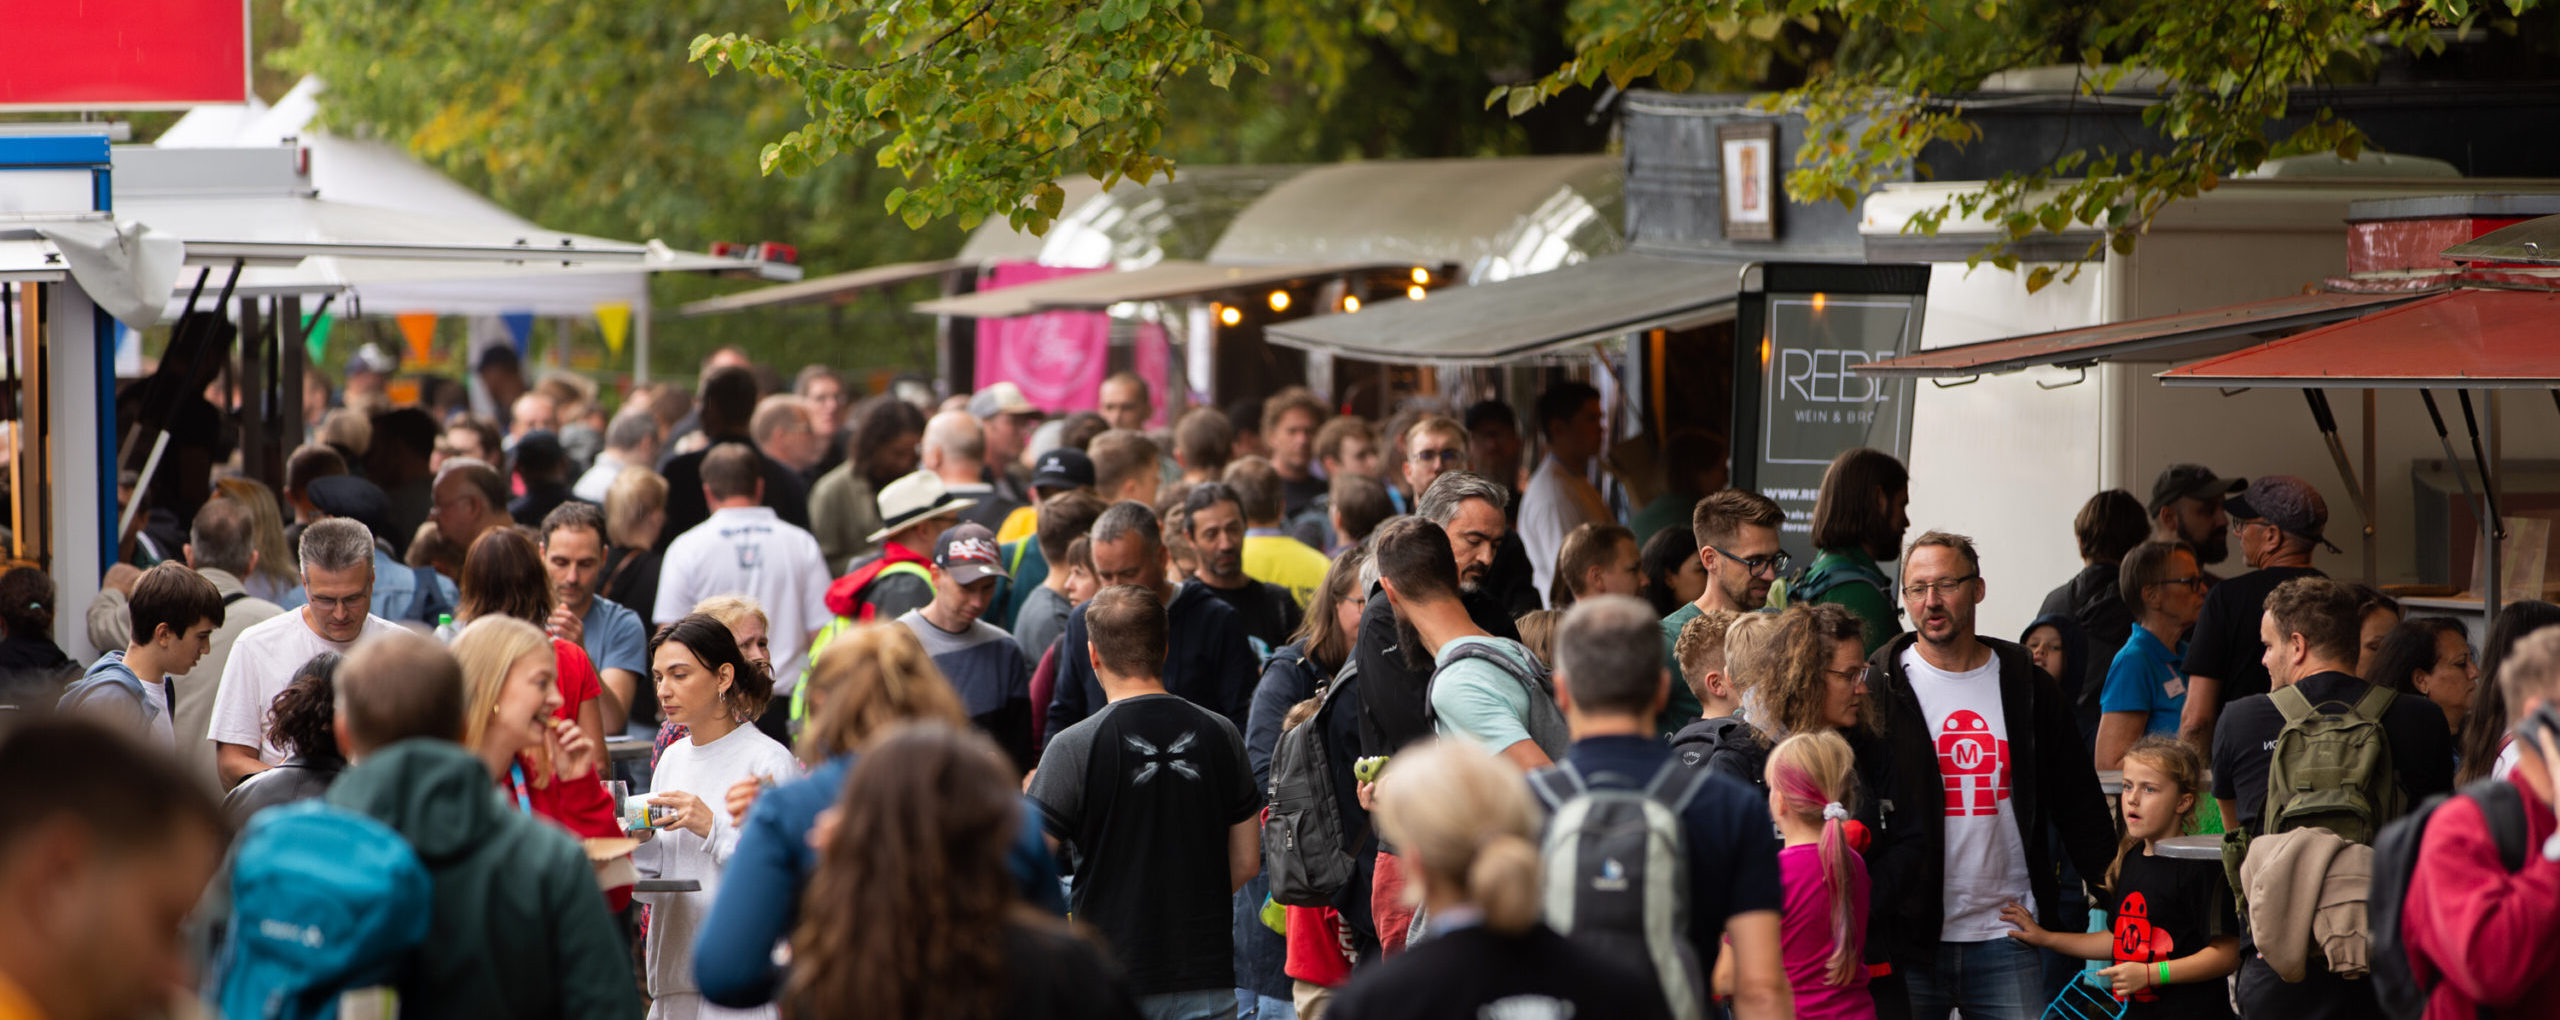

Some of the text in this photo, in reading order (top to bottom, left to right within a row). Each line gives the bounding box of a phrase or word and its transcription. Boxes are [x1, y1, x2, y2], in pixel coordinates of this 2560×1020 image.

[1795, 409, 1828, 423] WEIN
[1832, 410, 1841, 423] &
[1956, 743, 1978, 764] M
[2123, 927, 2139, 950] M
